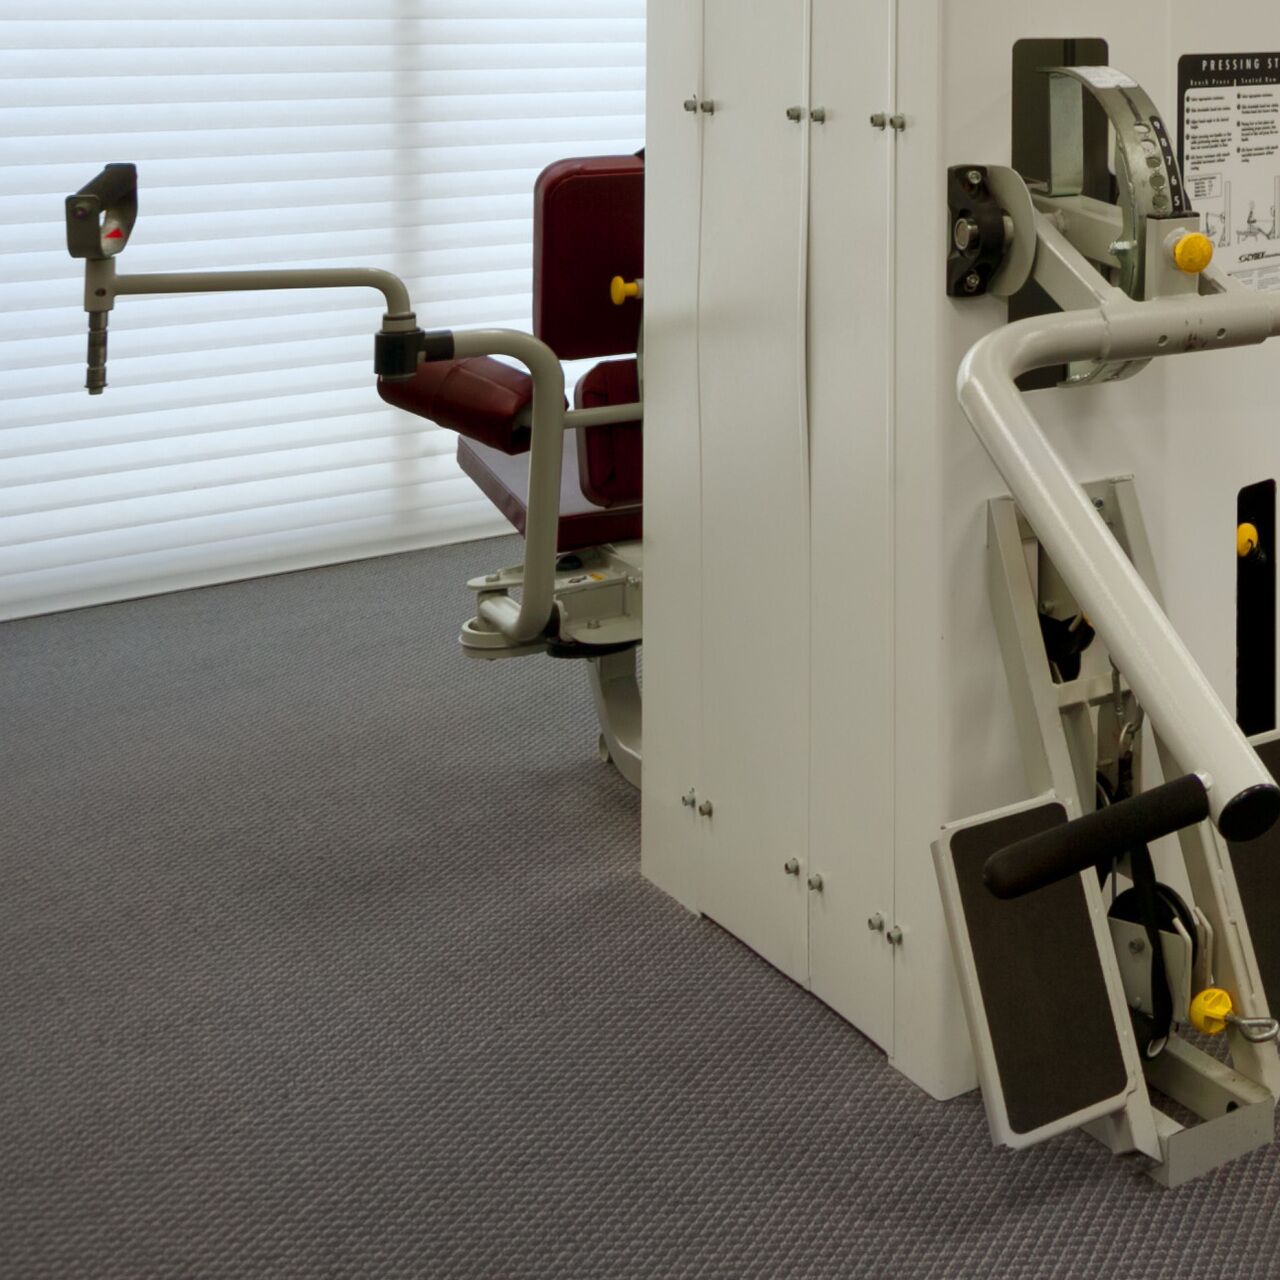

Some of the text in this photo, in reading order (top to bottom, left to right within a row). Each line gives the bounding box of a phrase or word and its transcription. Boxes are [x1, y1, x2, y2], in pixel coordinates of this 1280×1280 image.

[1201, 58, 1261, 72] PRESSING
[1153, 120, 1161, 131] 9
[1166, 156, 1173, 166] 7
[1171, 176, 1178, 185] 6
[1174, 195, 1181, 206] 5
